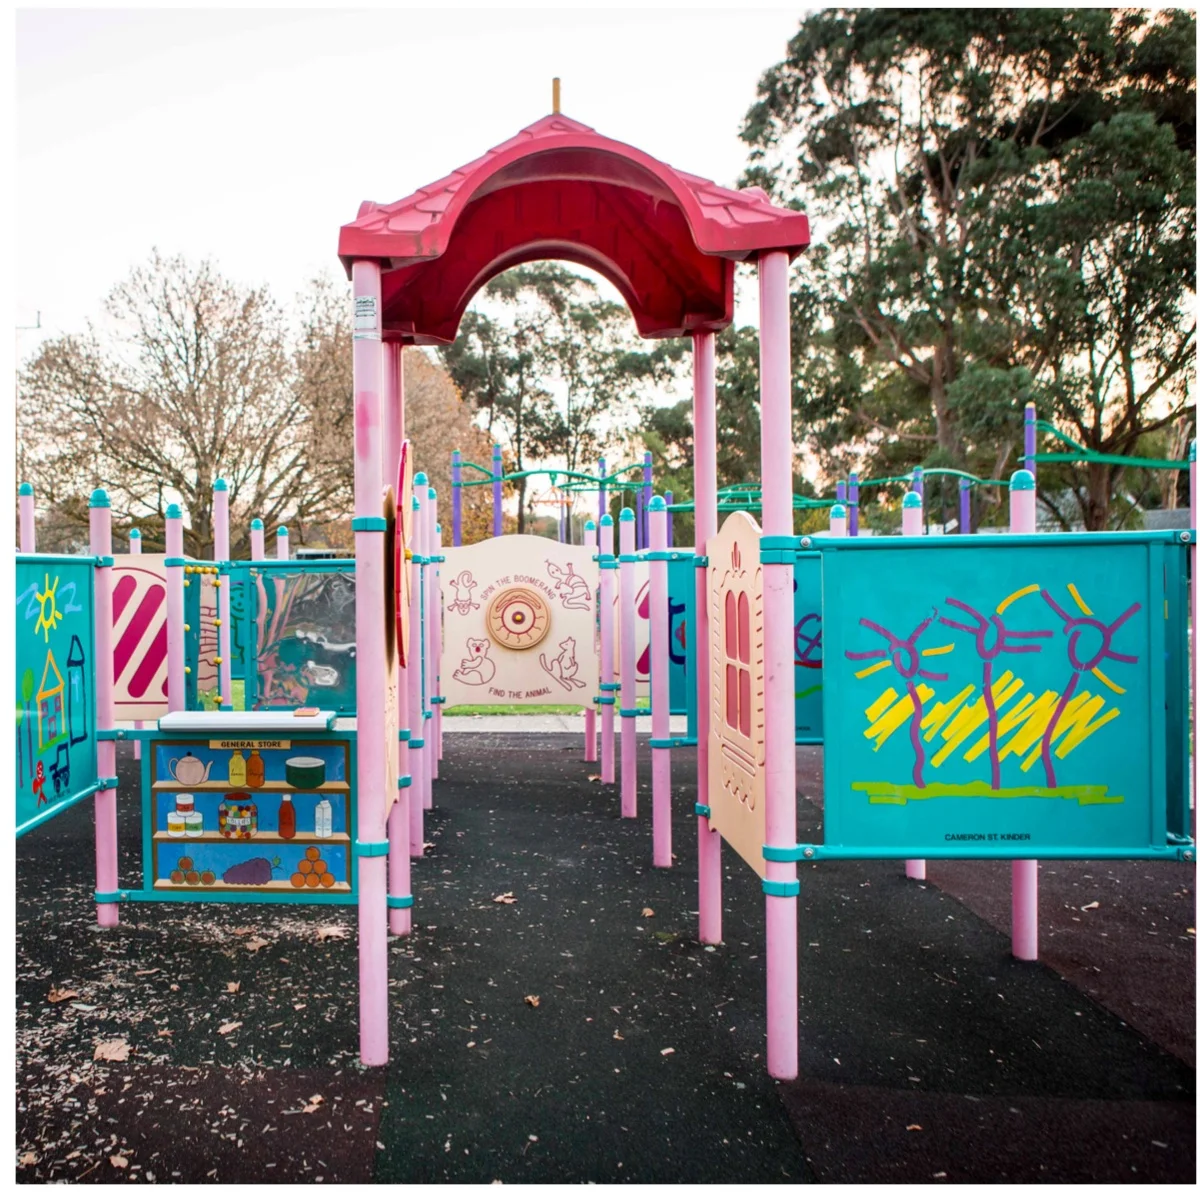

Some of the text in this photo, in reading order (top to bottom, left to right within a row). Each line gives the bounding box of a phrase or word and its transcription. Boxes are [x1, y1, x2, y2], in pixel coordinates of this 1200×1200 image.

[480, 574, 556, 600] SPIN THE BOOMERANG
[488, 686, 552, 699] FIND THE ANIMAL
[944, 832, 986, 841] CAMERON
[1000, 832, 1031, 841] KINDER
